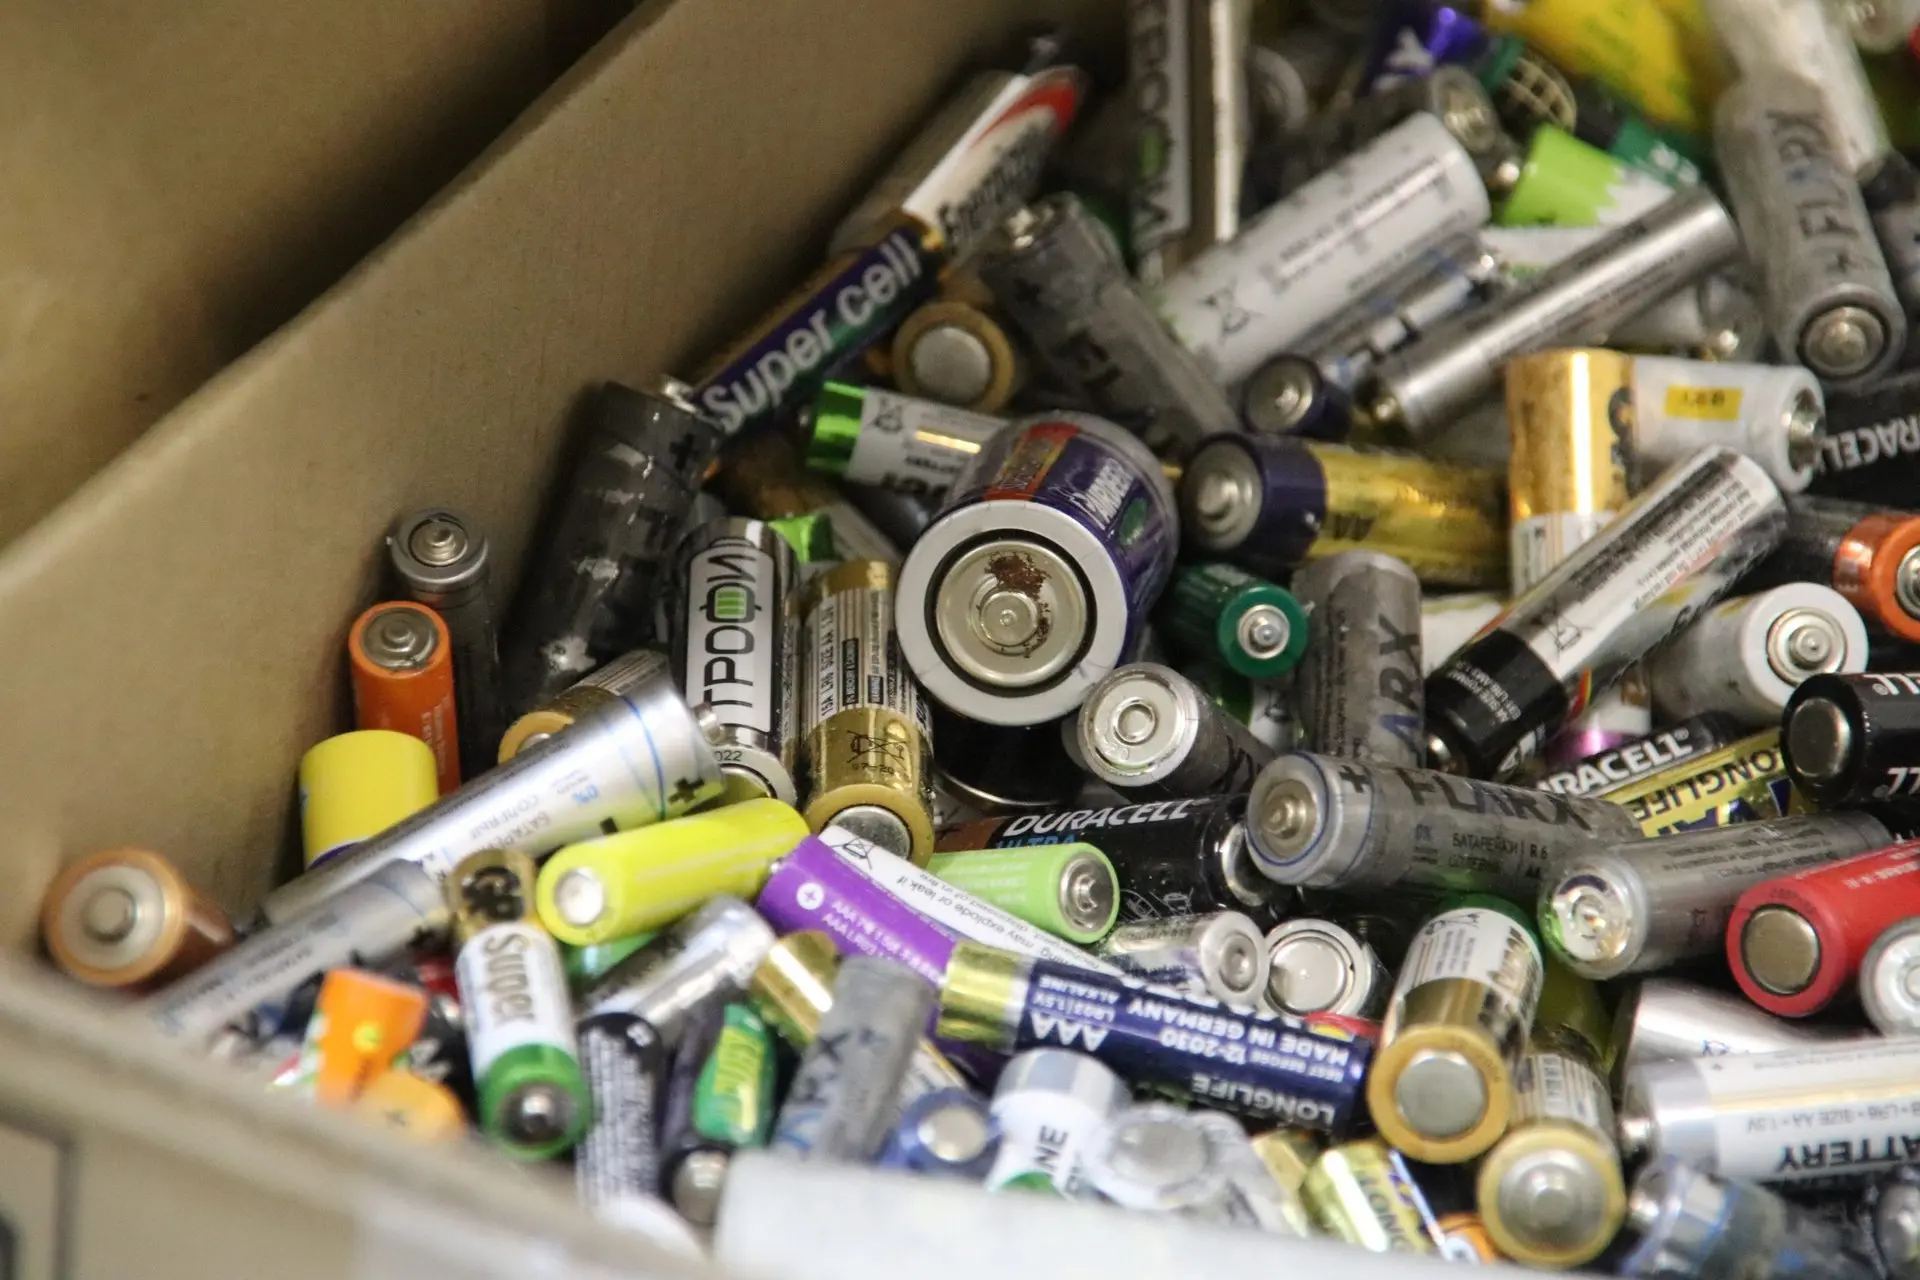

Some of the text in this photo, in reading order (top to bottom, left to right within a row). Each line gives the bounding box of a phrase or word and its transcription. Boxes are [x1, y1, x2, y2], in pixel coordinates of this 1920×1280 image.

[703, 233, 912, 434] Super cell
[1815, 415, 1920, 472] RACEL
[699, 553, 763, 709] ТРОФИ
[1626, 745, 1782, 821] ONGLIFE
[1003, 800, 1194, 837] DURACELL
[908, 878, 937, 902] leak
[935, 893, 953, 909] or
[953, 897, 1008, 939] explode
[1026, 1012, 1109, 1054] AAA
[1126, 996, 1352, 1067] MADE IN GERMANY
[1157, 1025, 1249, 1066] 12-2030
[1188, 1072, 1338, 1126] LONGLIFE
